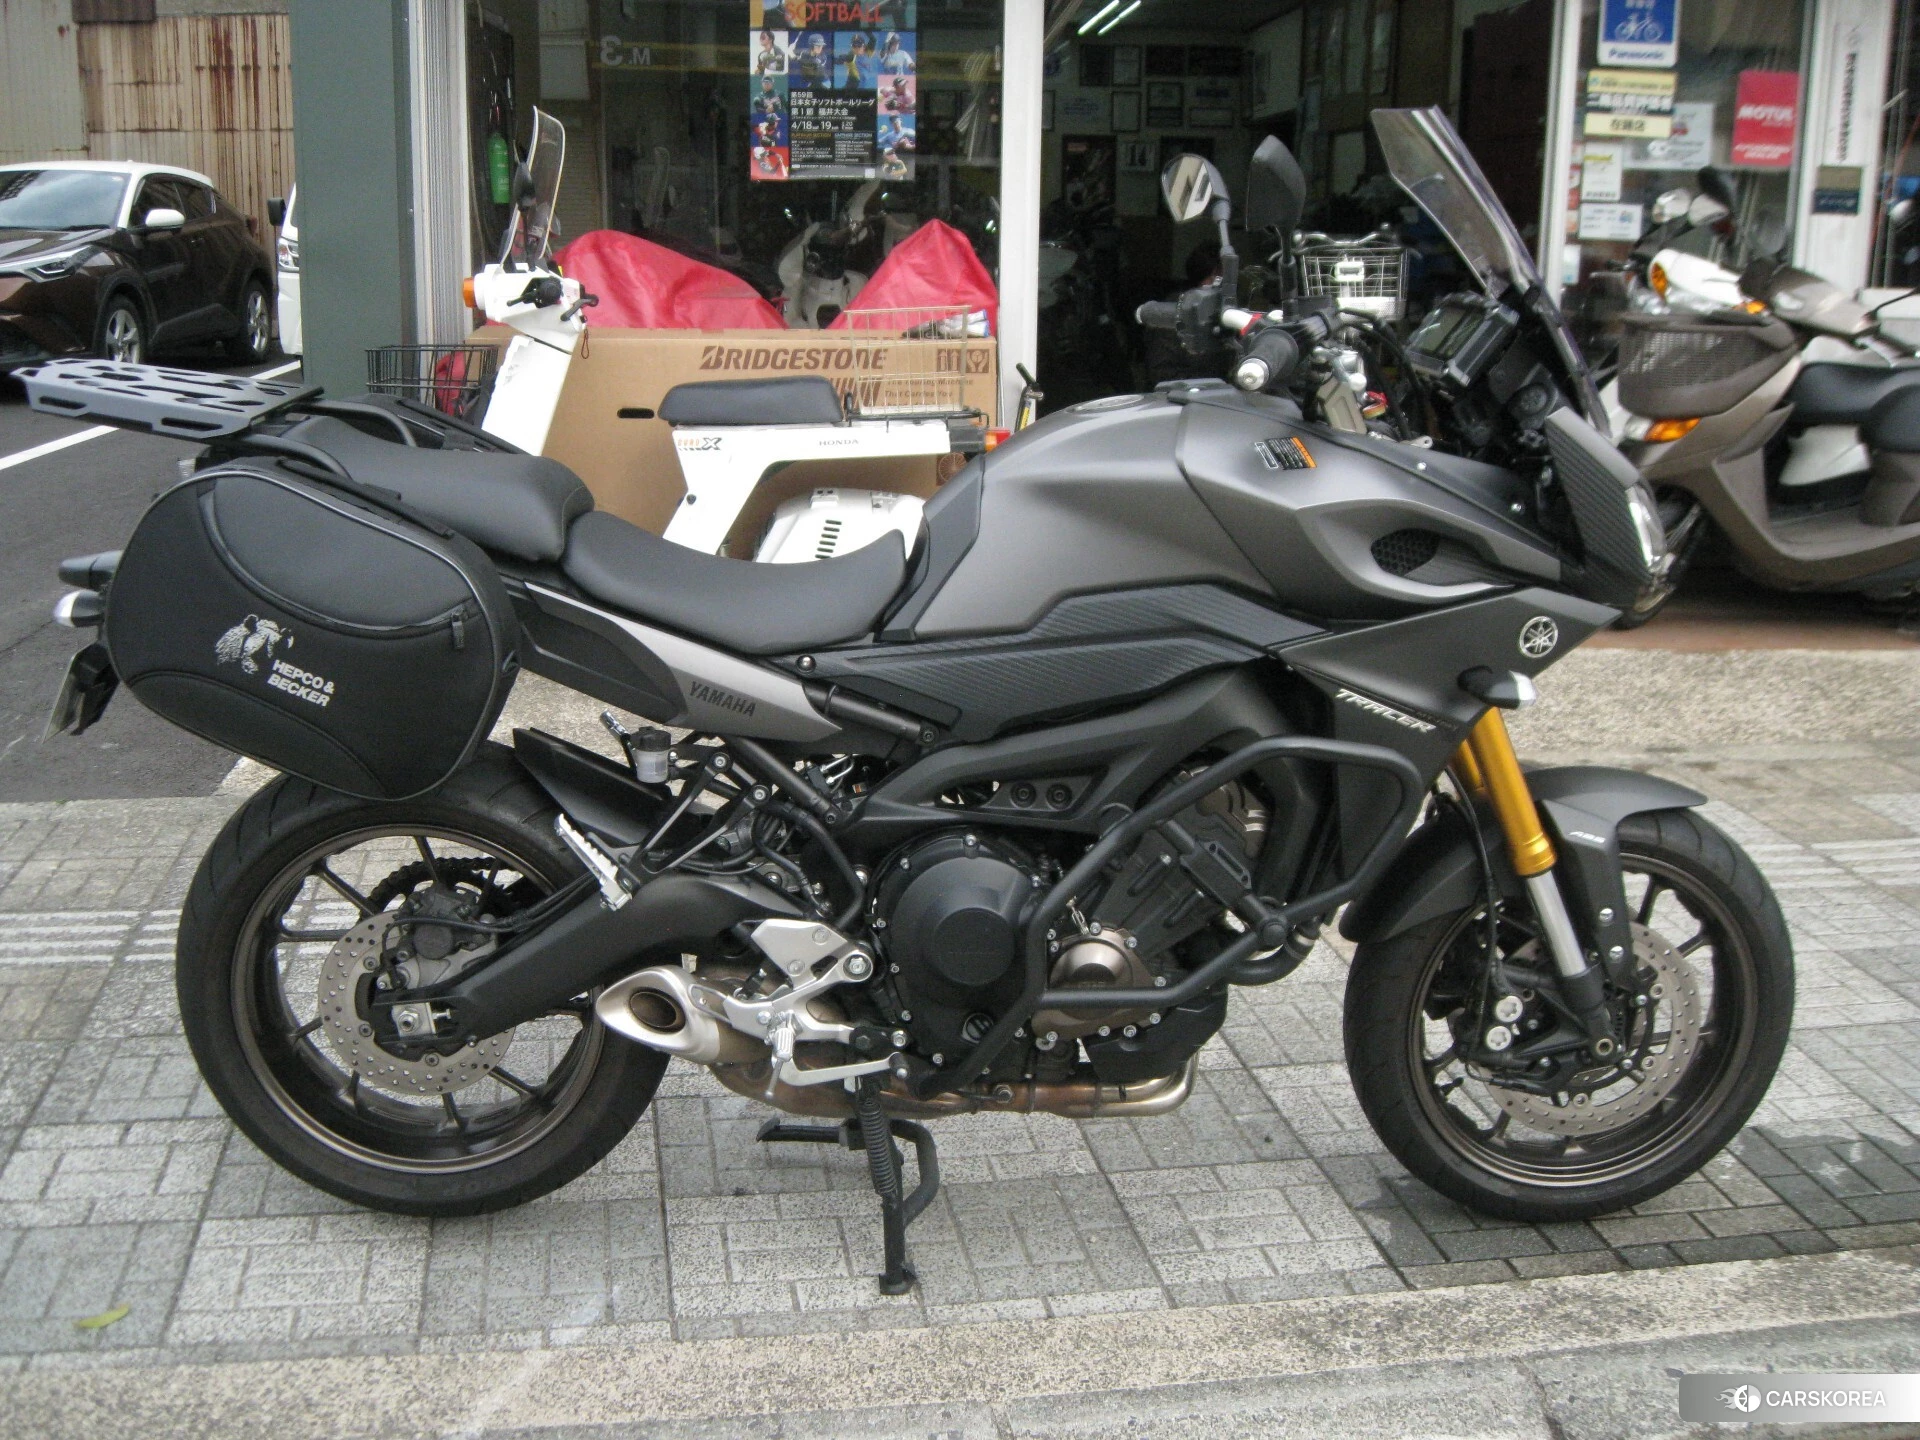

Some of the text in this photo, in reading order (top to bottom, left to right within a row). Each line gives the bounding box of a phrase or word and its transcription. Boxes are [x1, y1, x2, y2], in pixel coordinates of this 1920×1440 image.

[784, 2, 884, 23] SOFTBALL
[790, 98, 876, 106] 日本女子ソフトボールリーグ
[1737, 104, 1793, 120] MOTUL
[791, 121, 812, 130] 4/18
[820, 121, 832, 130] 19
[700, 345, 888, 370] BRIDGESTONE
[818, 439, 859, 447] HONDA
[272, 659, 335, 694] HEPCO &
[267, 674, 331, 706] BECKER
[690, 681, 756, 717] YAMAHA
[1335, 688, 1437, 733] TRACER
